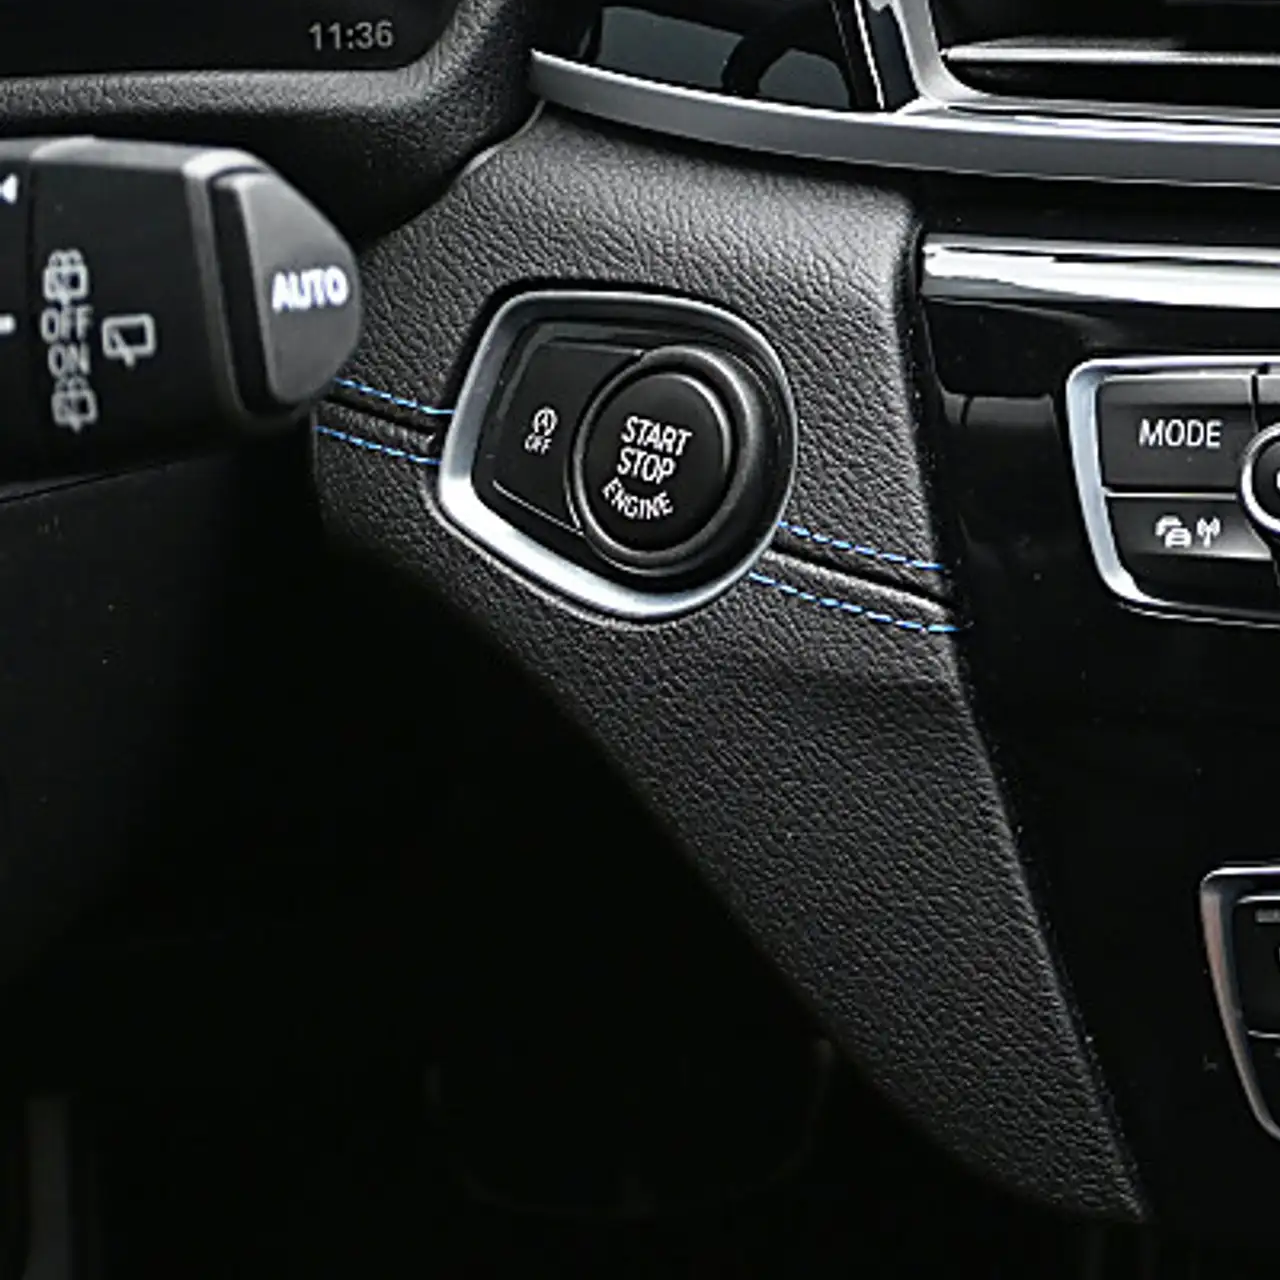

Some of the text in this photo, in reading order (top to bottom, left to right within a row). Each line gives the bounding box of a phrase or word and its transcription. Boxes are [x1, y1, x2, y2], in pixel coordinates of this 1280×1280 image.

[309, 22, 394, 51] 11:36
[272, 267, 348, 311] AUTO
[40, 308, 93, 342] OFF
[49, 346, 91, 375] ON
[524, 436, 552, 454] OFF
[621, 415, 692, 456] START
[1139, 418, 1222, 449] MODE
[617, 448, 675, 485] STOP
[601, 477, 674, 521] ENGINE
